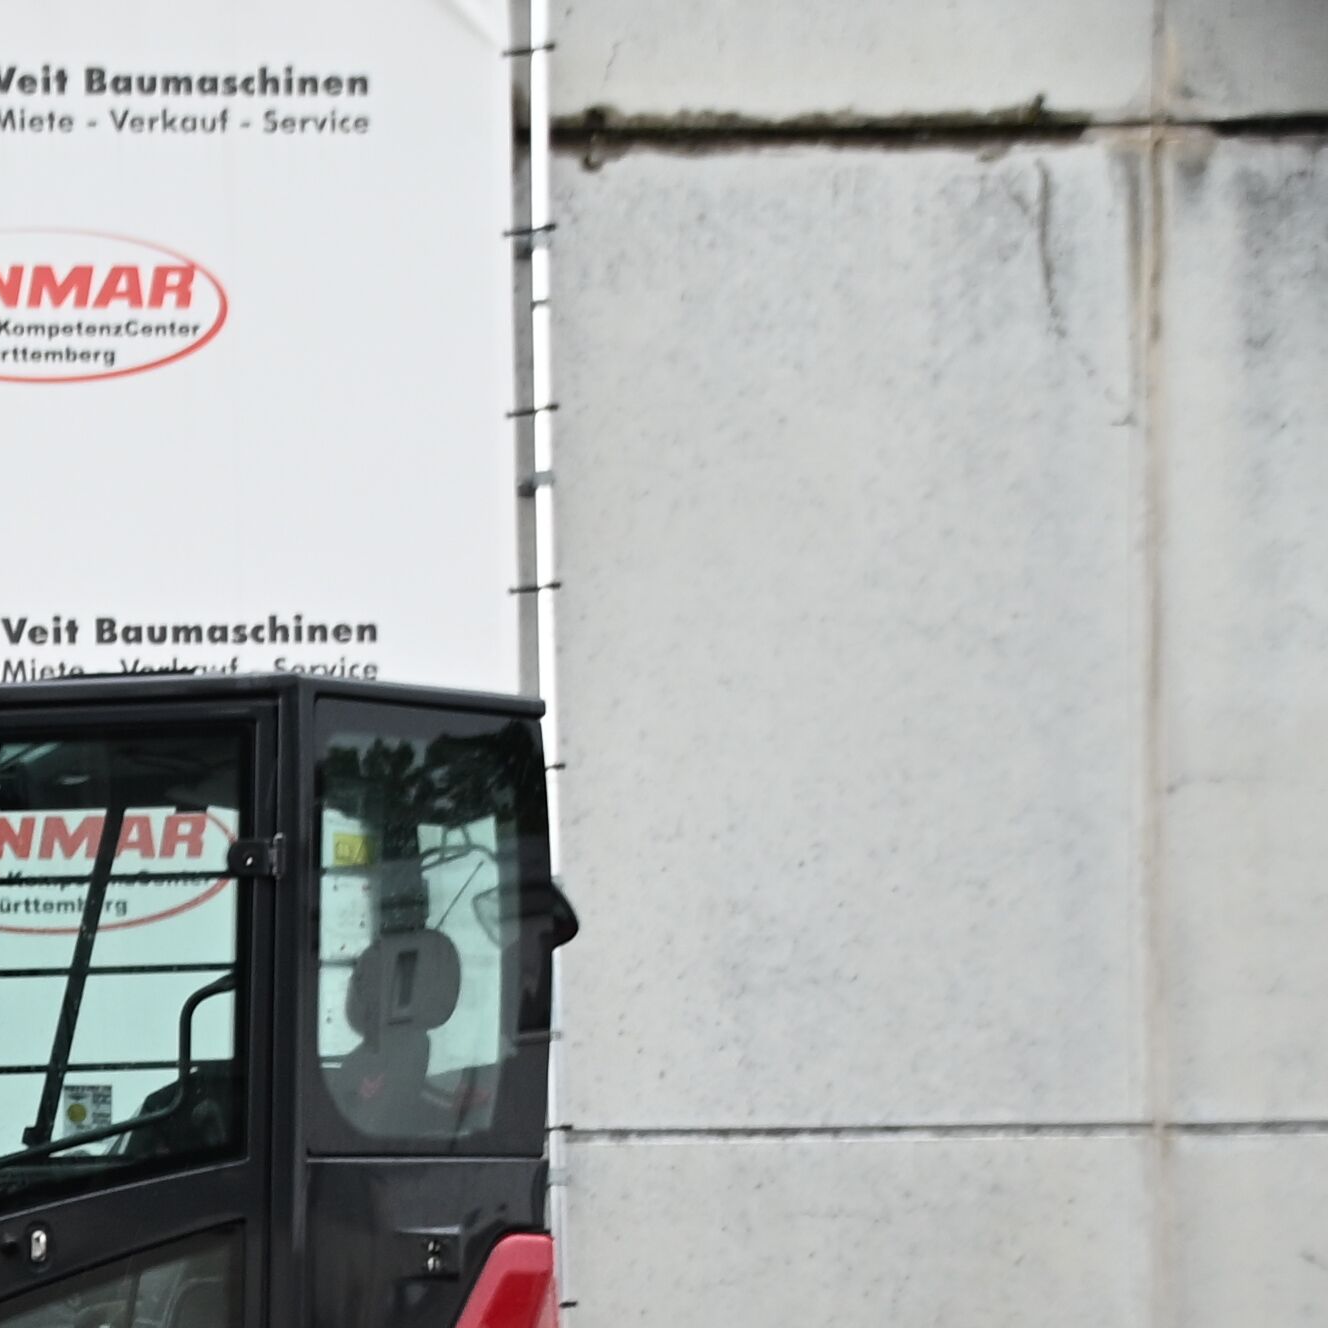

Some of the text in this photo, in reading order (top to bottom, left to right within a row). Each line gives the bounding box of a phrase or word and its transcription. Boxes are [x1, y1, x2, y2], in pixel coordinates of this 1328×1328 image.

[85, 66, 368, 96] Baumaschinen
[110, 108, 228, 133] Verkauf
[264, 109, 369, 133] Service
[1, 614, 377, 645] Veit Baumaschinen
